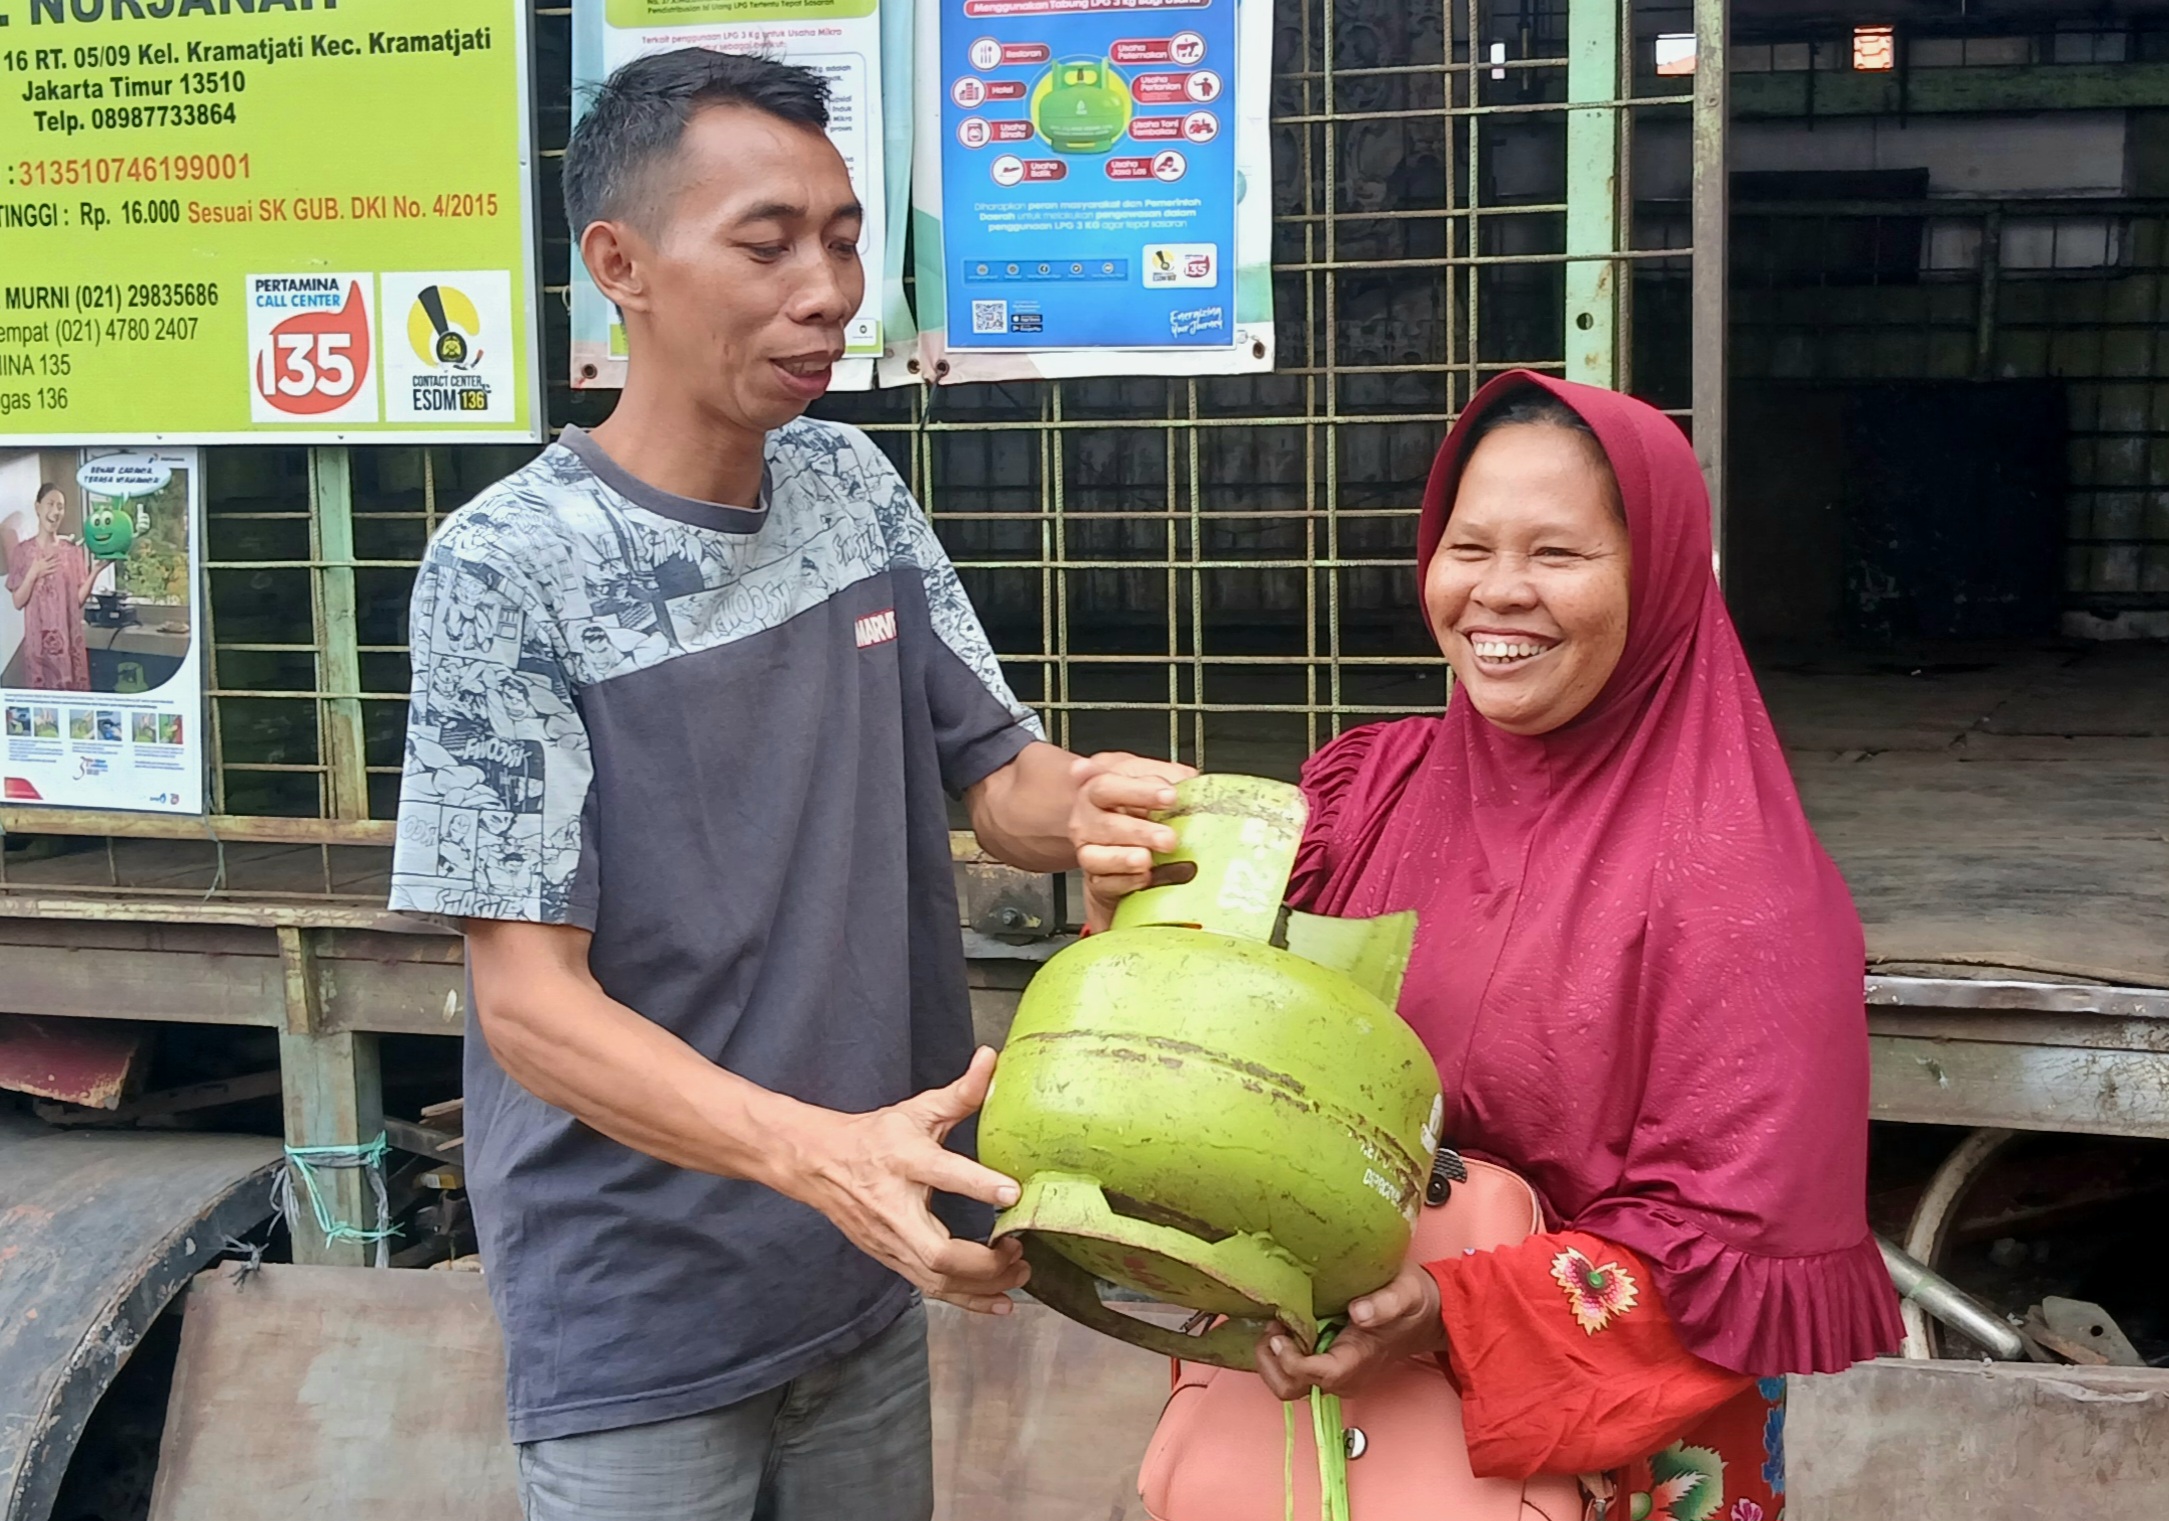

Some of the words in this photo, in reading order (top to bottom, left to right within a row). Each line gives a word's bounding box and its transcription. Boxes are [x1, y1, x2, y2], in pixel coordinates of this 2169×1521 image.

[31, 0, 337, 25] NURJ
[4, 49, 28, 71] 16
[36, 48, 67, 70] RT.
[74, 45, 130, 68] 05/09
[138, 42, 179, 65] Kel.
[187, 35, 303, 65] Kramatjati
[311, 34, 361, 57] Kec.
[368, 27, 491, 57] Kramatjati
[22, 78, 103, 101] Jakarta
[110, 76, 172, 97] Timur
[180, 70, 245, 94] 13510
[33, 109, 84, 135] Telp.
[91, 102, 236, 129] 08987733864
[80, 201, 110, 231] Rp.
[121, 198, 180, 225] 16.000
[188, 199, 253, 224] Sesuai
[259, 198, 287, 222] SK
[293, 197, 344, 221] GUB.
[351, 195, 386, 219] DKI
[394, 195, 426, 218] No.
[432, 193, 497, 217] 4/2015
[6, 285, 69, 309] MURNI
[76, 283, 122, 314] (021)
[127, 282, 219, 308] 29835686
[255, 278, 340, 292] PERTAMINA
[256, 294, 287, 307] CALL
[291, 294, 341, 307] CENTER
[0, 321, 49, 348] empat
[55, 318, 100, 348] (021)
[105, 317, 150, 341] 4780
[155, 316, 198, 340] 2407
[0, 354, 35, 376] INA
[39, 353, 71, 376] 135
[261, 332, 355, 397] 135
[413, 375, 448, 388] CONTACT
[450, 375, 482, 388] CENTER
[37, 386, 68, 410] 136
[413, 388, 457, 411] ESDM
[462, 390, 485, 409] 136
